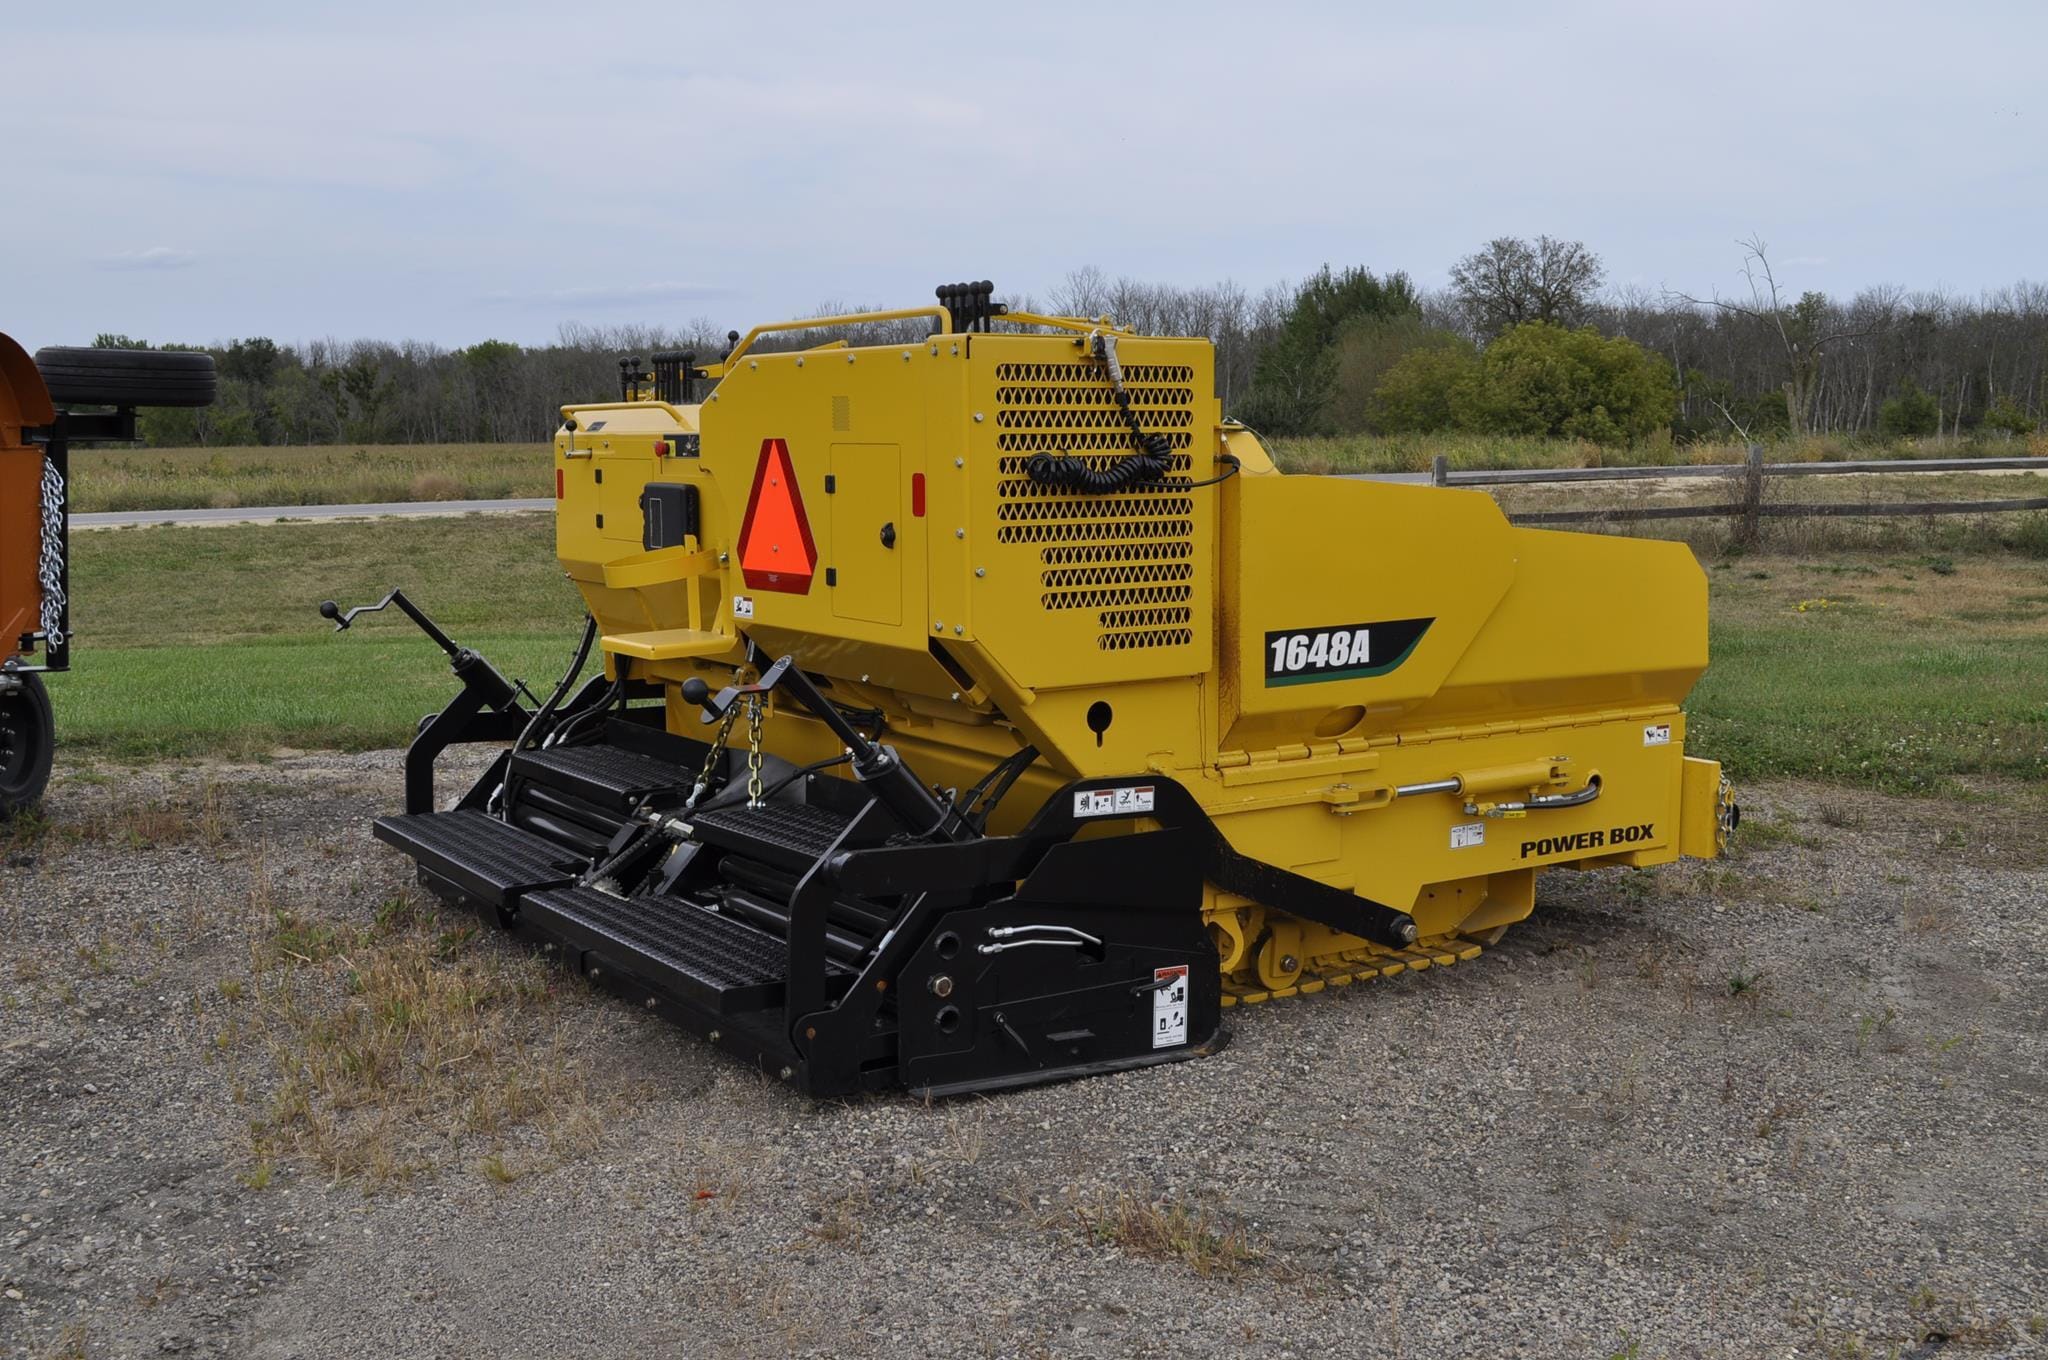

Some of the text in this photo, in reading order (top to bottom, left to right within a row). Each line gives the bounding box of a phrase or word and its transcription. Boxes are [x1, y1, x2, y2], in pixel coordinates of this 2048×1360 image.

[1271, 629, 1370, 673] 1648A
[1521, 823, 1655, 859] POWER BOX
